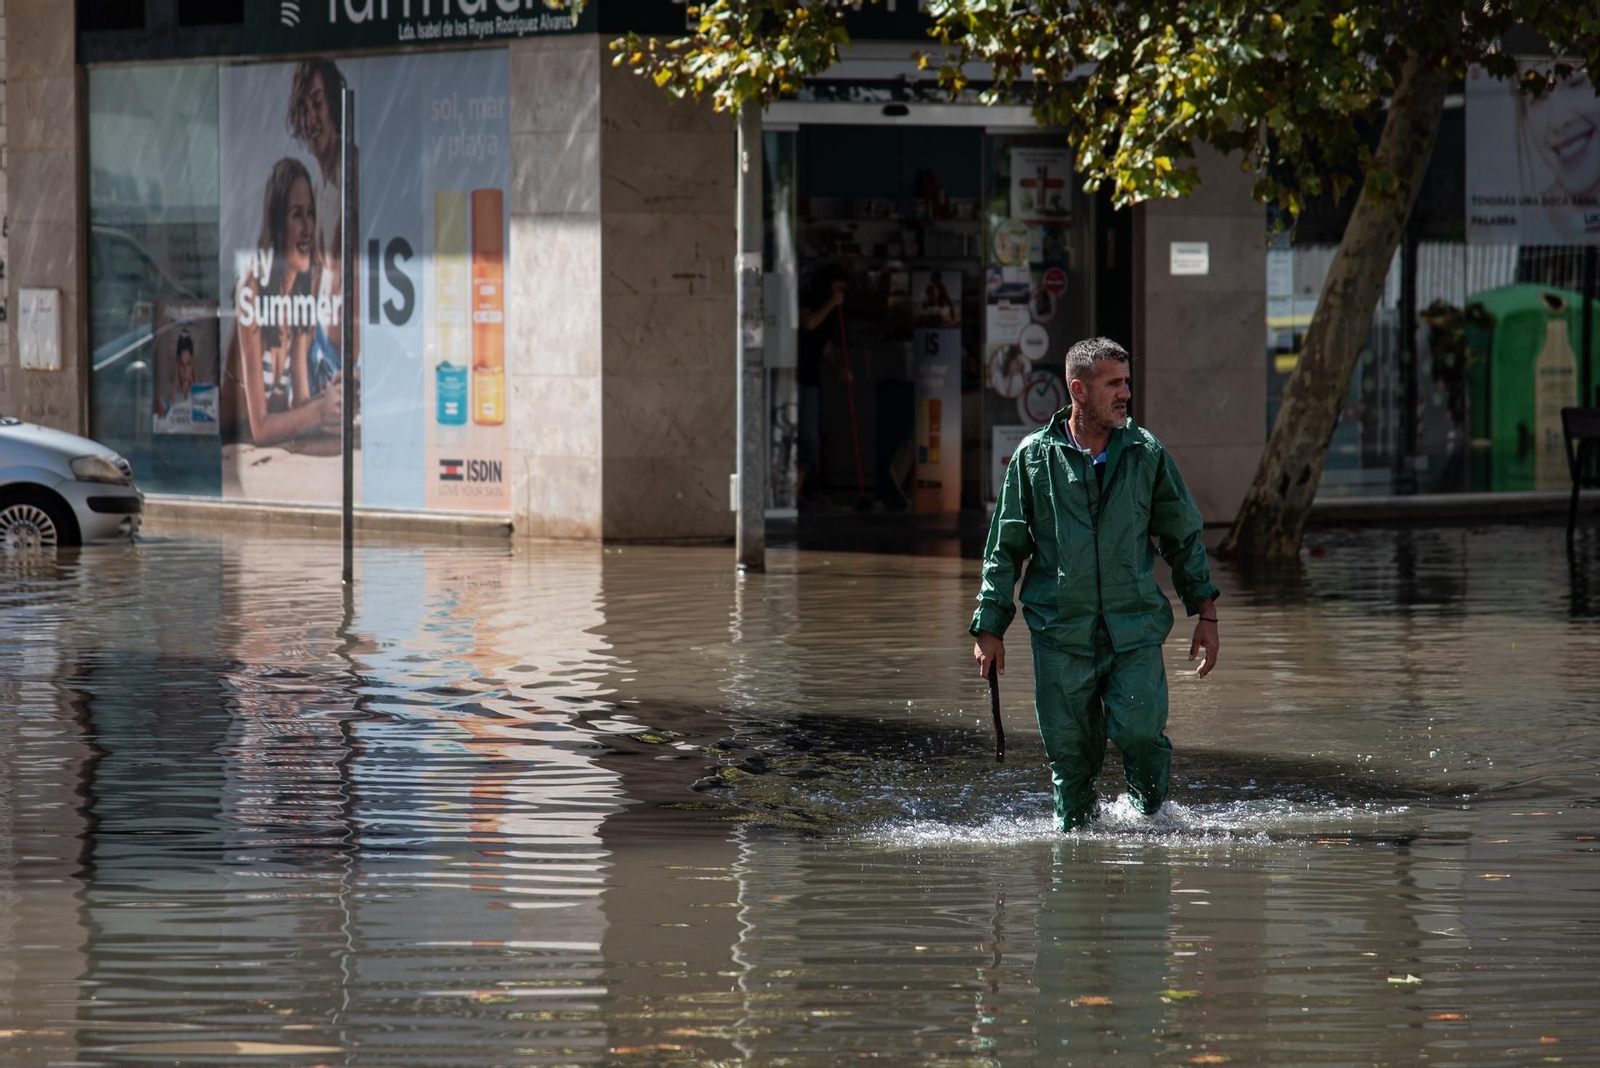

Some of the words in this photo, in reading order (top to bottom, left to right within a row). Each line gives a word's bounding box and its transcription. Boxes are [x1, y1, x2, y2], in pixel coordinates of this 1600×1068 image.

[397, 22, 415, 41] Lda.
[416, 20, 442, 39] Isabel
[443, 19, 454, 38] de
[454, 18, 468, 37] los
[468, 17, 494, 40] Reyes
[468, 94, 506, 121] mar
[431, 135, 446, 165] y
[447, 127, 499, 165] playa
[1518, 197, 1539, 207] UNA
[1471, 214, 1517, 226] PALABRA
[368, 235, 416, 327] IS
[239, 286, 343, 327] Summer
[466, 459, 502, 482] ISDIN
[438, 484, 459, 497] LOVE
[461, 485, 483, 498] YOUR
[484, 486, 503, 498] SKIN
